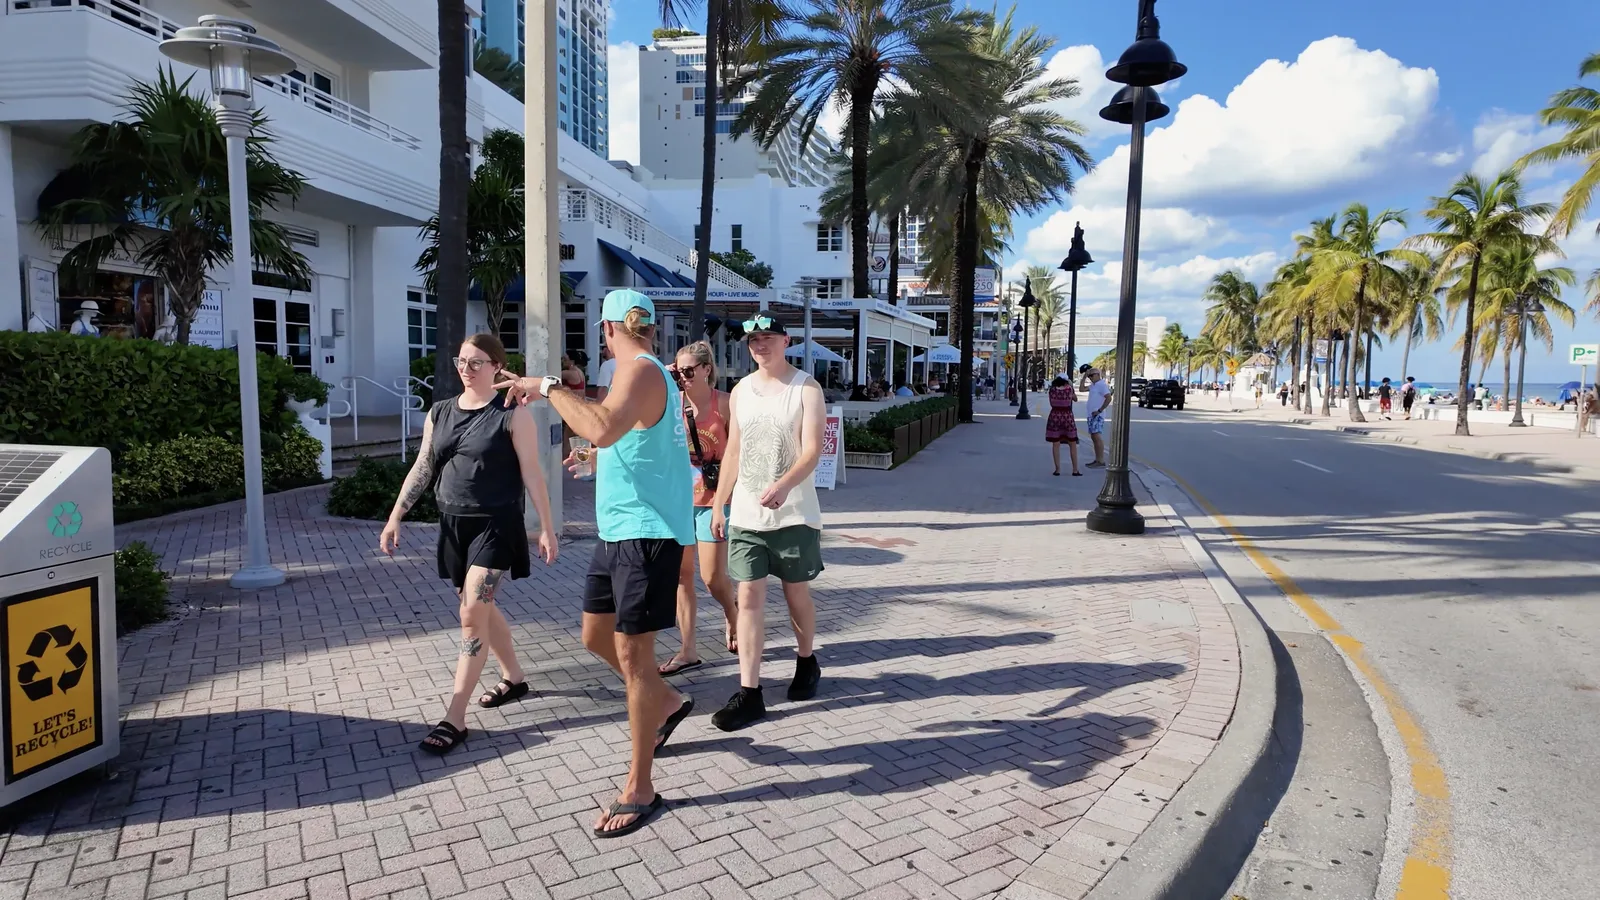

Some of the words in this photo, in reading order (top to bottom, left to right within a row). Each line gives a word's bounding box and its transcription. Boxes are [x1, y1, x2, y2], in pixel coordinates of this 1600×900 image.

[975, 281, 993, 290] 250
[1573, 347, 1585, 361] P
[39, 541, 93, 560] RECYCLE
[33, 708, 77, 735] LET'S
[15, 716, 93, 757] RECYCLE!
